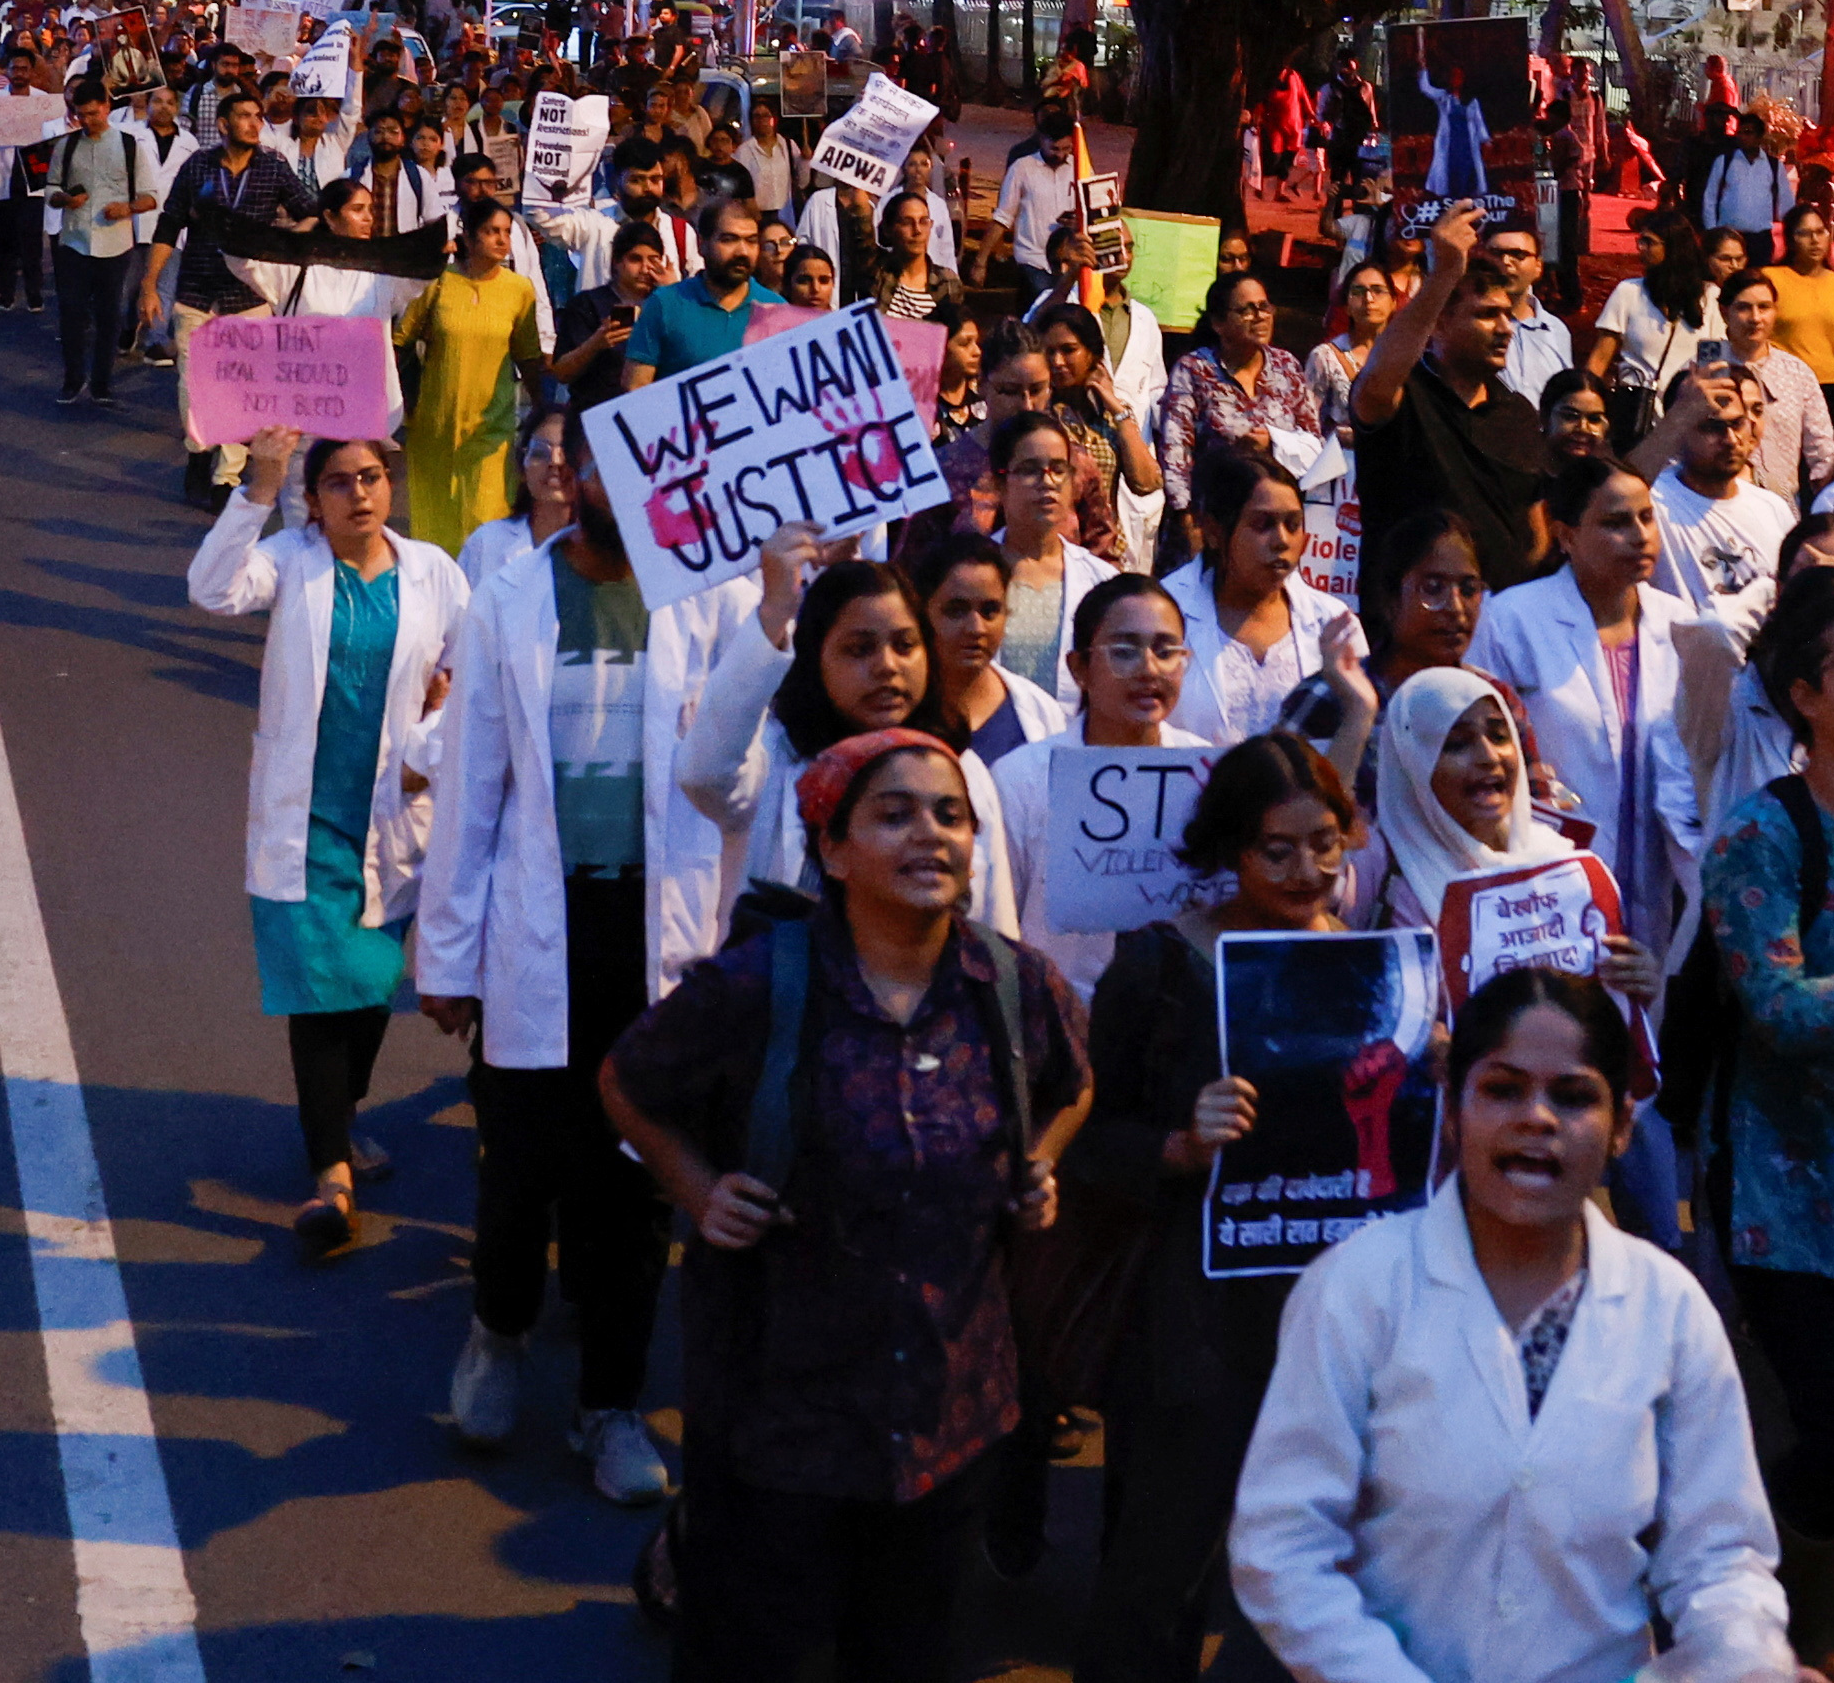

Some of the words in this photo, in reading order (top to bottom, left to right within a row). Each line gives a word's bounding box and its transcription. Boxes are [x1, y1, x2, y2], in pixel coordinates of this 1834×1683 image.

[539, 107, 567, 124] NOT
[533, 150, 563, 167] NOT
[819, 145, 889, 188] AIPWA
[269, 322, 328, 353] THAT
[274, 361, 350, 387] SHOULD
[613, 364, 754, 476] WE
[741, 303, 900, 427] WANT
[661, 410, 939, 572] JUSTICE
[1080, 764, 1195, 842] ST
[1237, 1213, 1283, 1248] सारी
